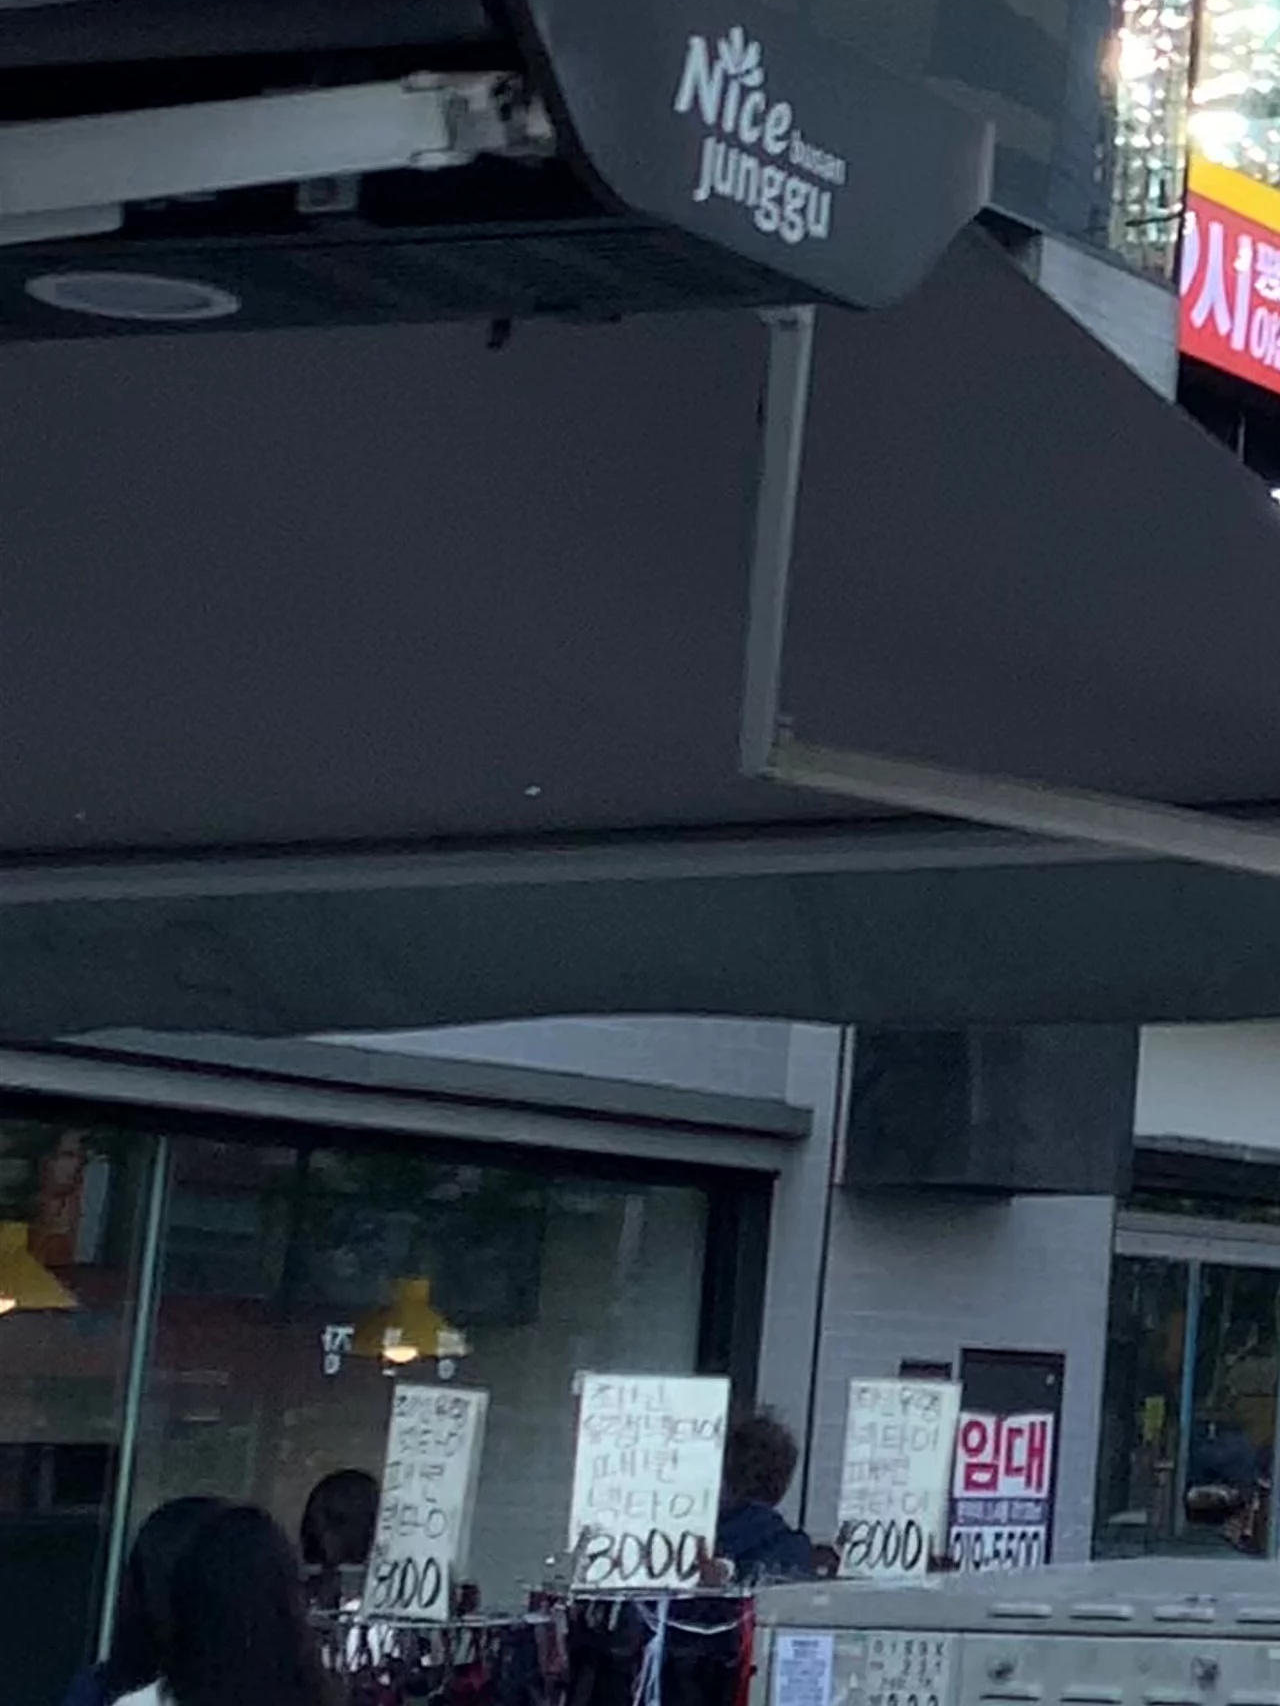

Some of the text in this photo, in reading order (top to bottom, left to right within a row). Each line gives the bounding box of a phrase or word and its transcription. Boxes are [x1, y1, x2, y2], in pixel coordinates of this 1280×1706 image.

[674, 25, 794, 147] Nice
[693, 132, 833, 246] junggu
[959, 1417, 1049, 1494] 임대
